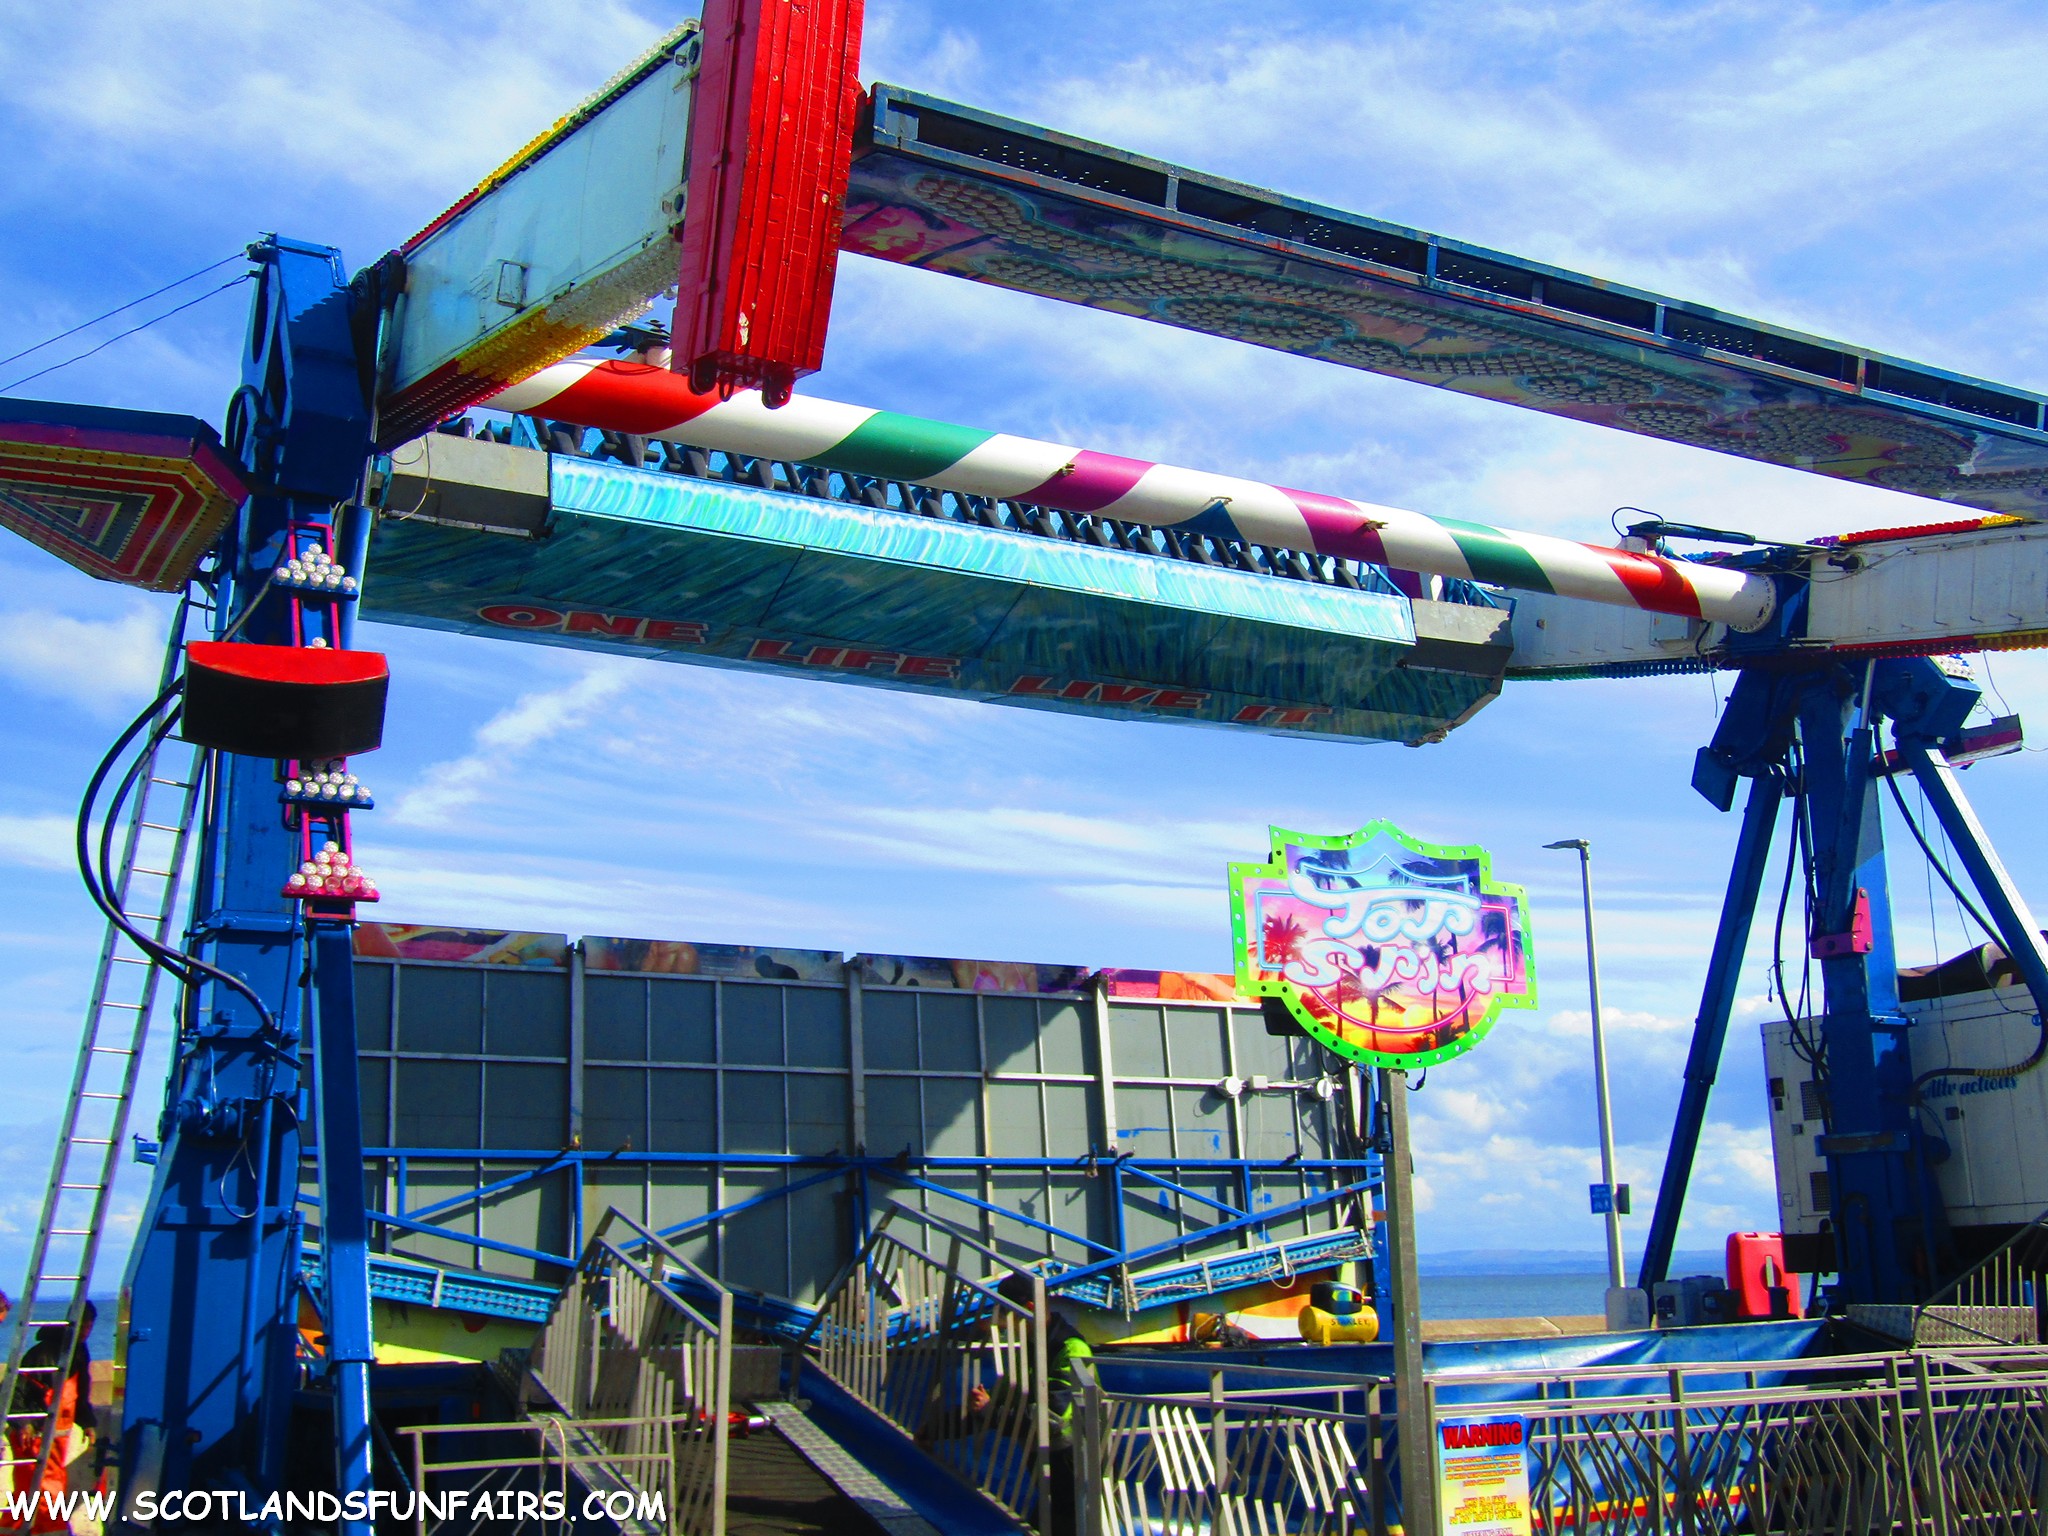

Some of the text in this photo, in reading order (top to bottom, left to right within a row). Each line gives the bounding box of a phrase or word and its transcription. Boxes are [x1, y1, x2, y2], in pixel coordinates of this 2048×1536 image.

[477, 604, 709, 644] ONE
[1008, 674, 1212, 709] LIVE
[1232, 704, 1333, 724] IT
[1443, 1421, 1522, 1449] WARNING
